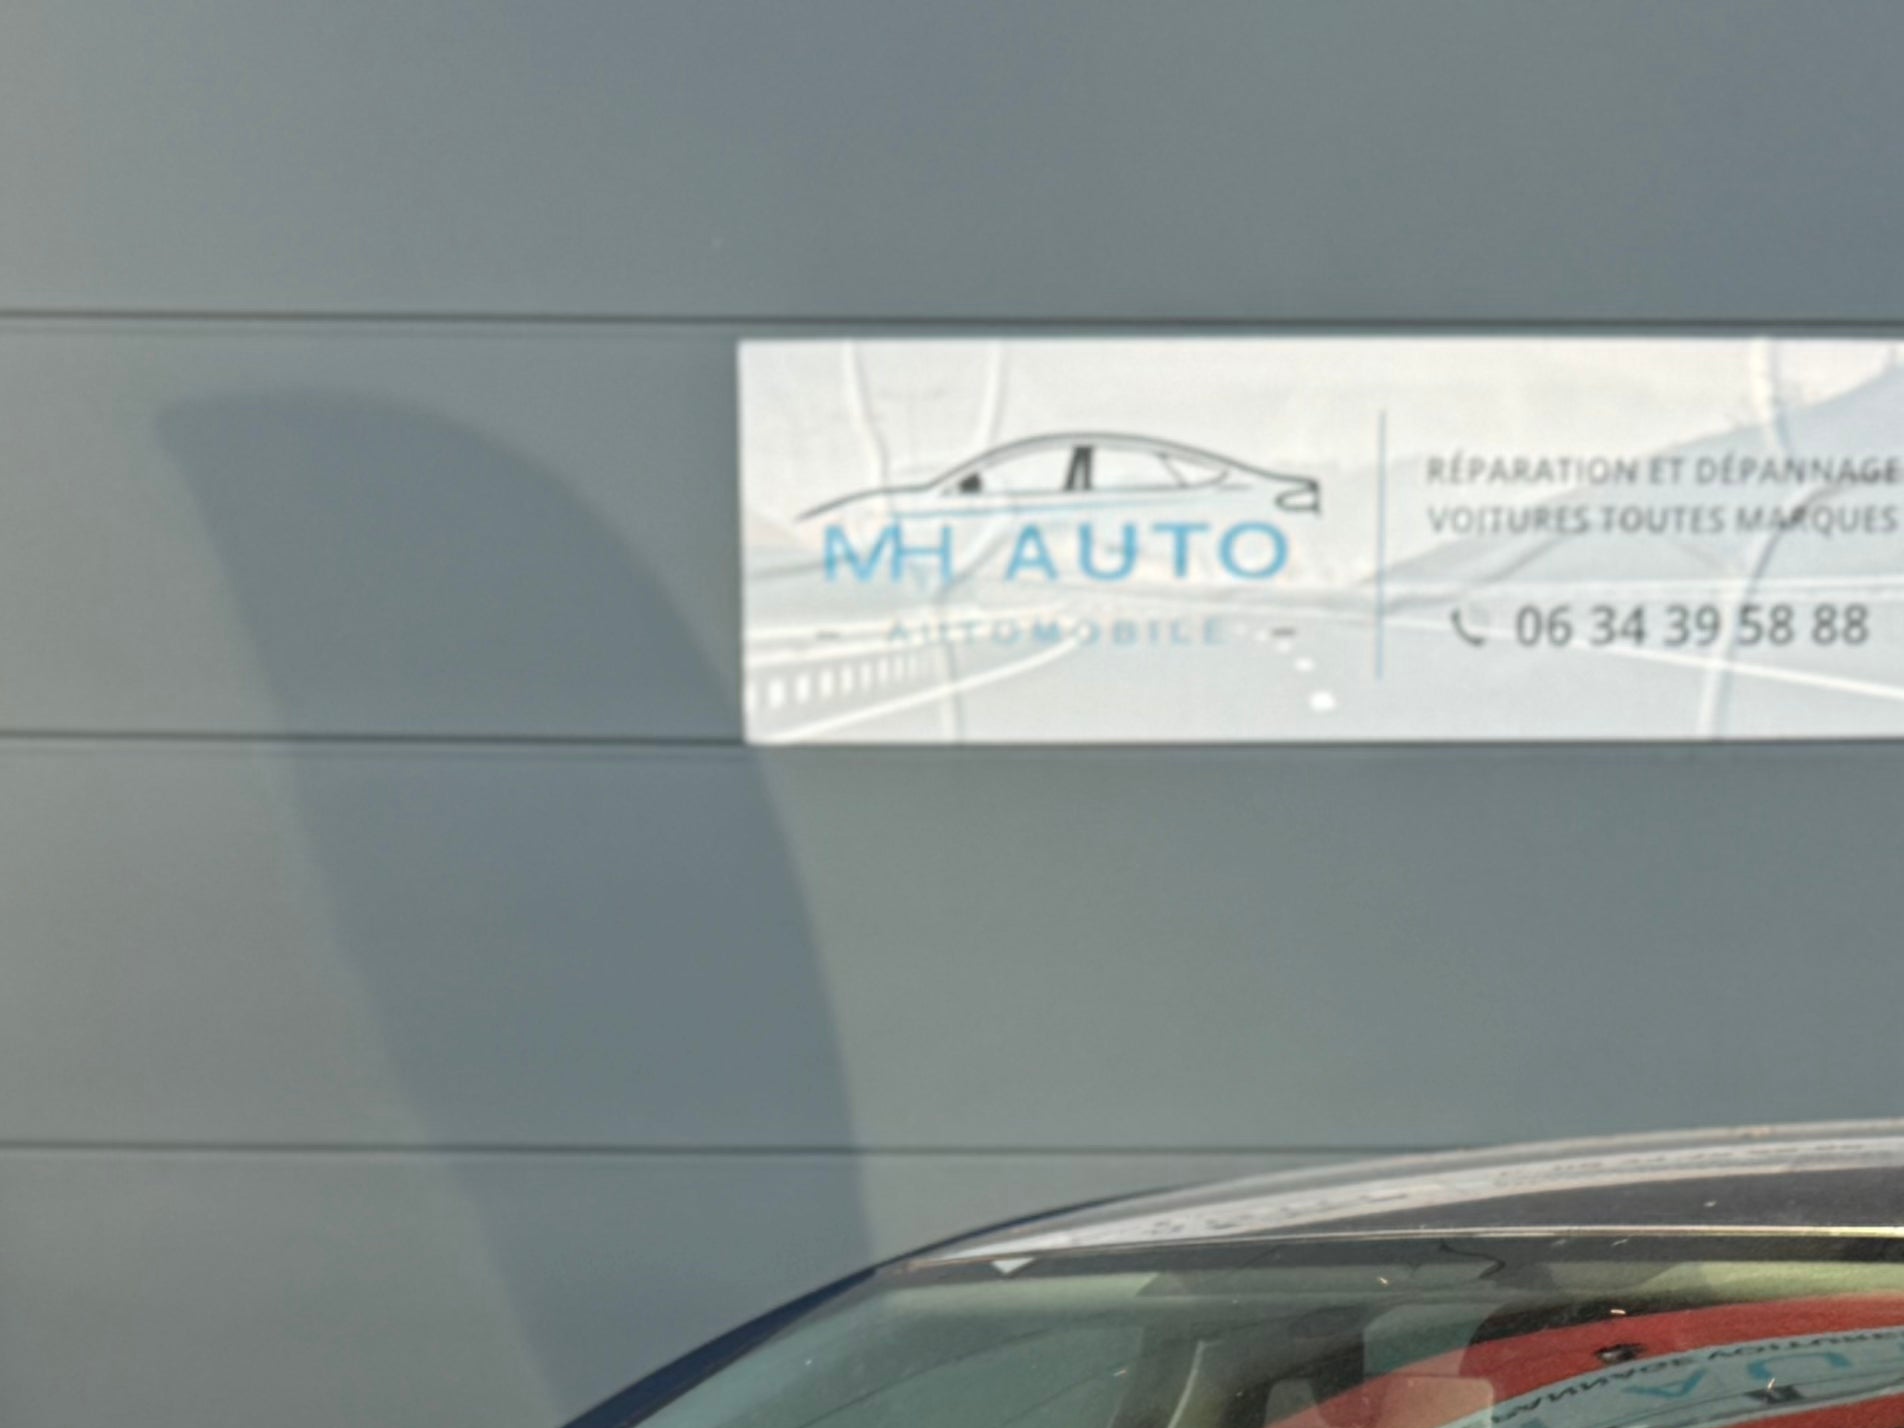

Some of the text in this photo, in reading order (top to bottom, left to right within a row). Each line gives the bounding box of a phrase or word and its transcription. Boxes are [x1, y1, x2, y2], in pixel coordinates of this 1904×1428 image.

[1426, 450, 1900, 485] RÉPARATION ET DÉPANNAGE
[1426, 505, 1900, 537] VOITURES TOUTES MARQUES
[1004, 520, 1290, 583] AUTO
[1515, 603, 1871, 648] 06 34 39 58 88
